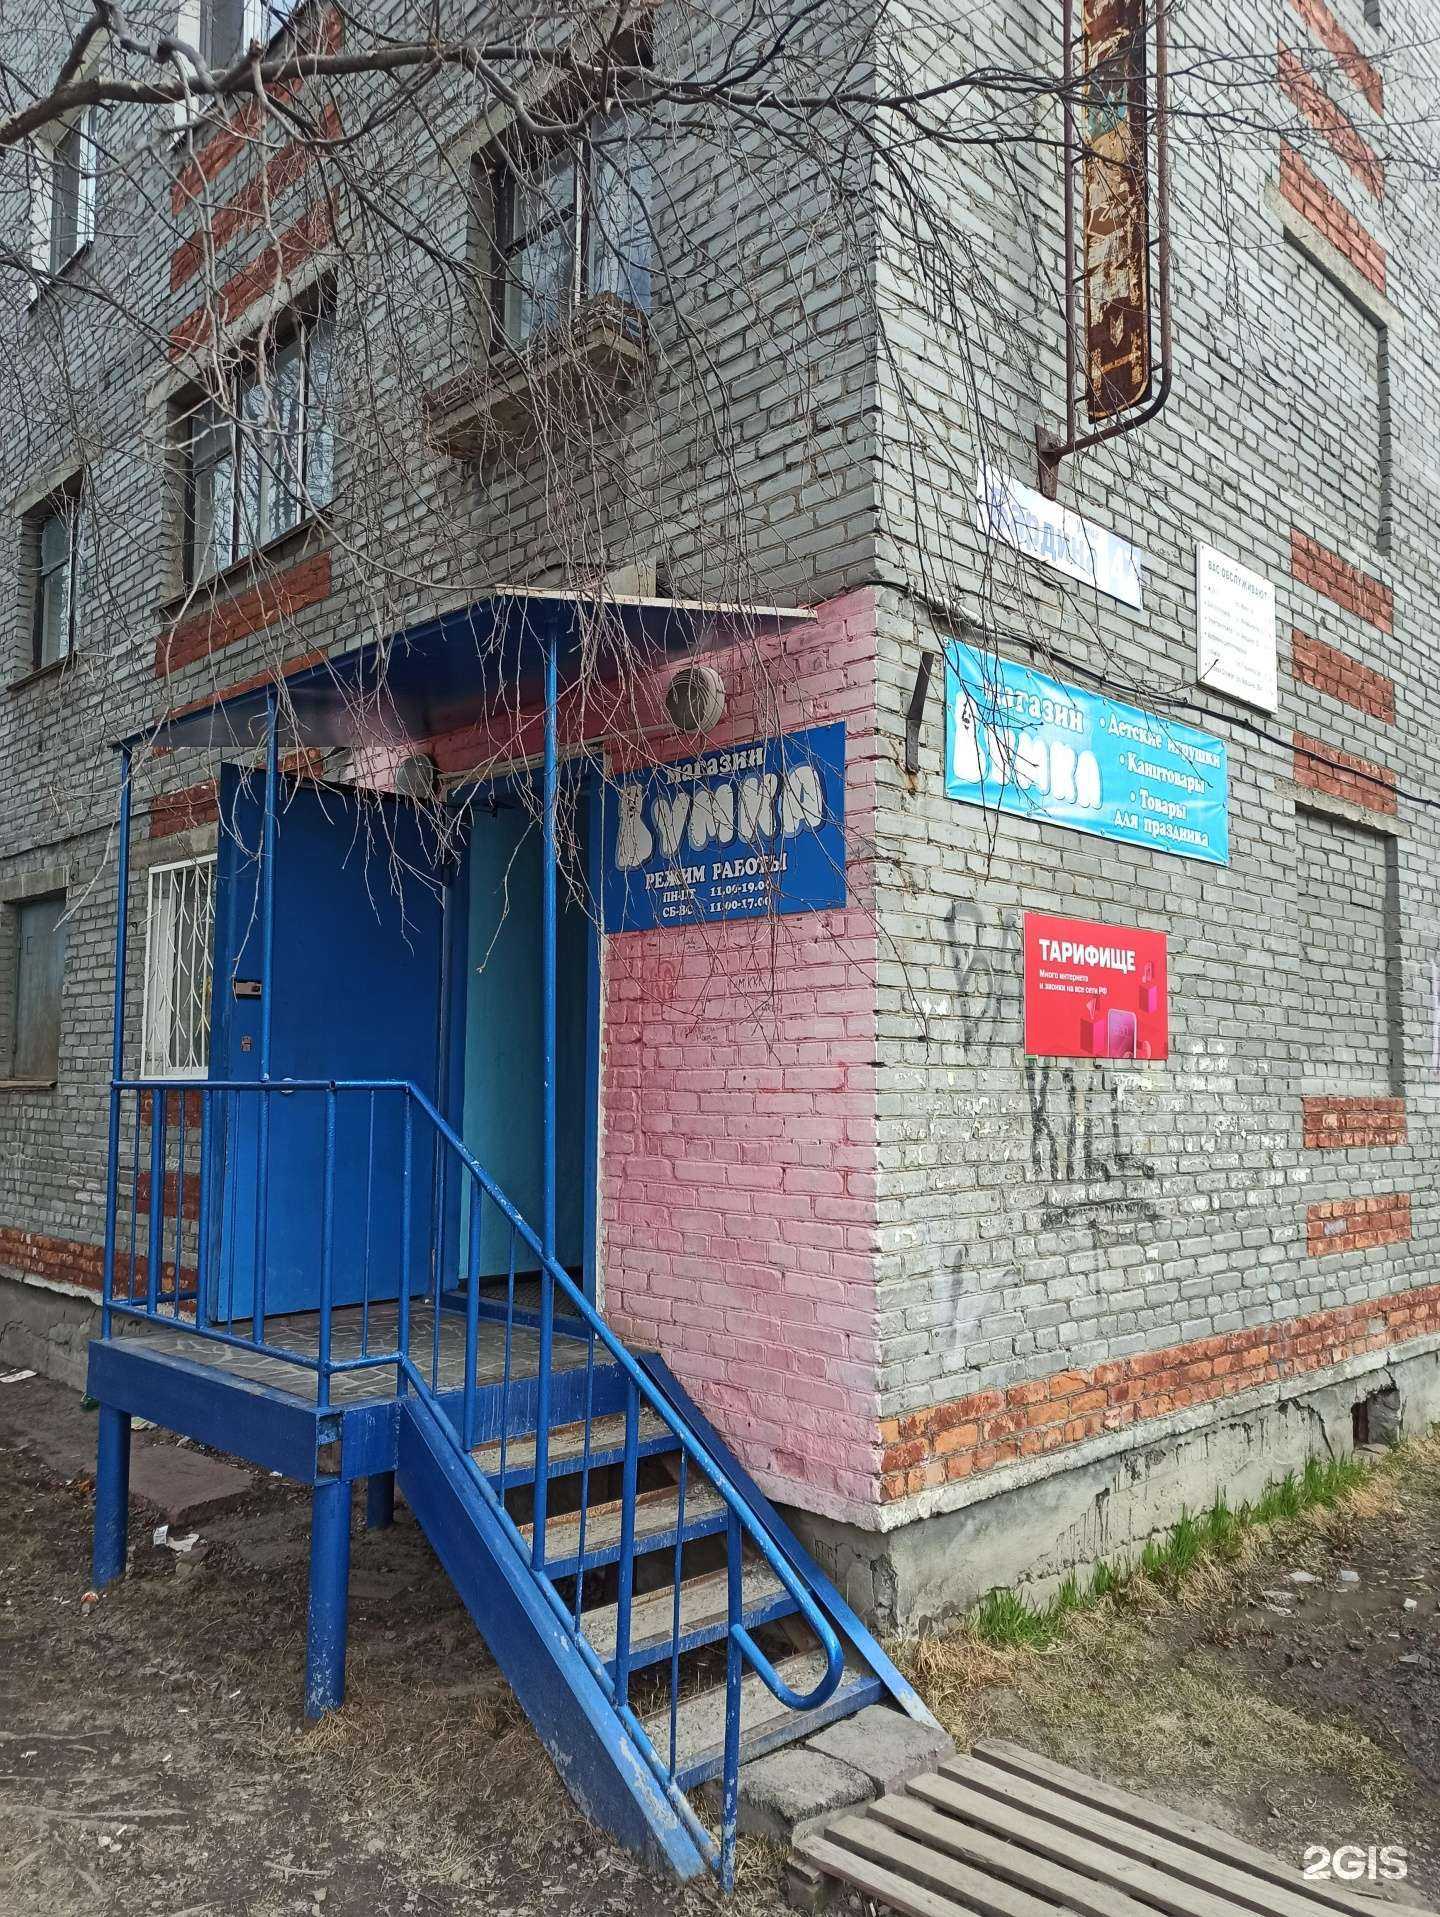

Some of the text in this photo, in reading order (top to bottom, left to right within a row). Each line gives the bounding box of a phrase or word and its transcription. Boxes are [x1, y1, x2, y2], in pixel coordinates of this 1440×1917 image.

[1139, 787, 1187, 820] Товары
[1143, 816, 1209, 848] праздника
[645, 853, 788, 890] РЕЖИМ РАБОТЫ
[1038, 938, 1136, 974] ТАРИФИЩЕ
[1039, 968, 1059, 980] Много
